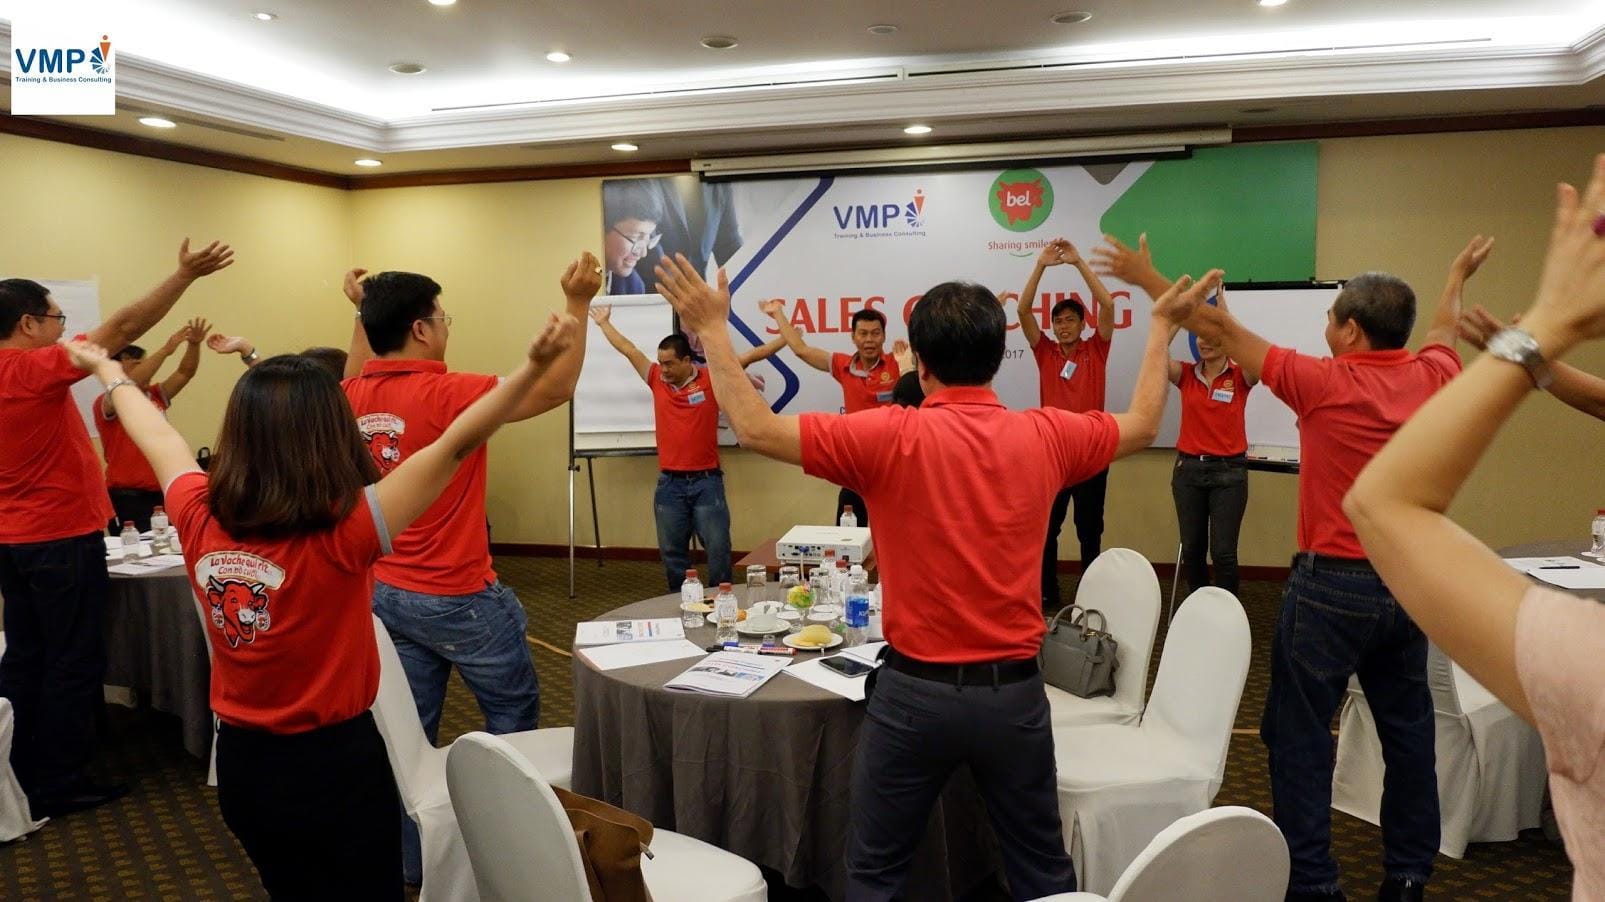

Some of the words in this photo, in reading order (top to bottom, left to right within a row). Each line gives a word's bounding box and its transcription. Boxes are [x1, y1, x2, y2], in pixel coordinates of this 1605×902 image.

[1006, 190, 1032, 207] bel
[833, 204, 900, 230] VMP
[834, 232, 858, 240] Training
[865, 231, 892, 239] Business
[893, 230, 926, 238] Consulting
[987, 241, 1022, 251] Sharing
[1002, 349, 1025, 360] 017
[210, 557, 220, 567] La
[246, 559, 258, 569] qui
